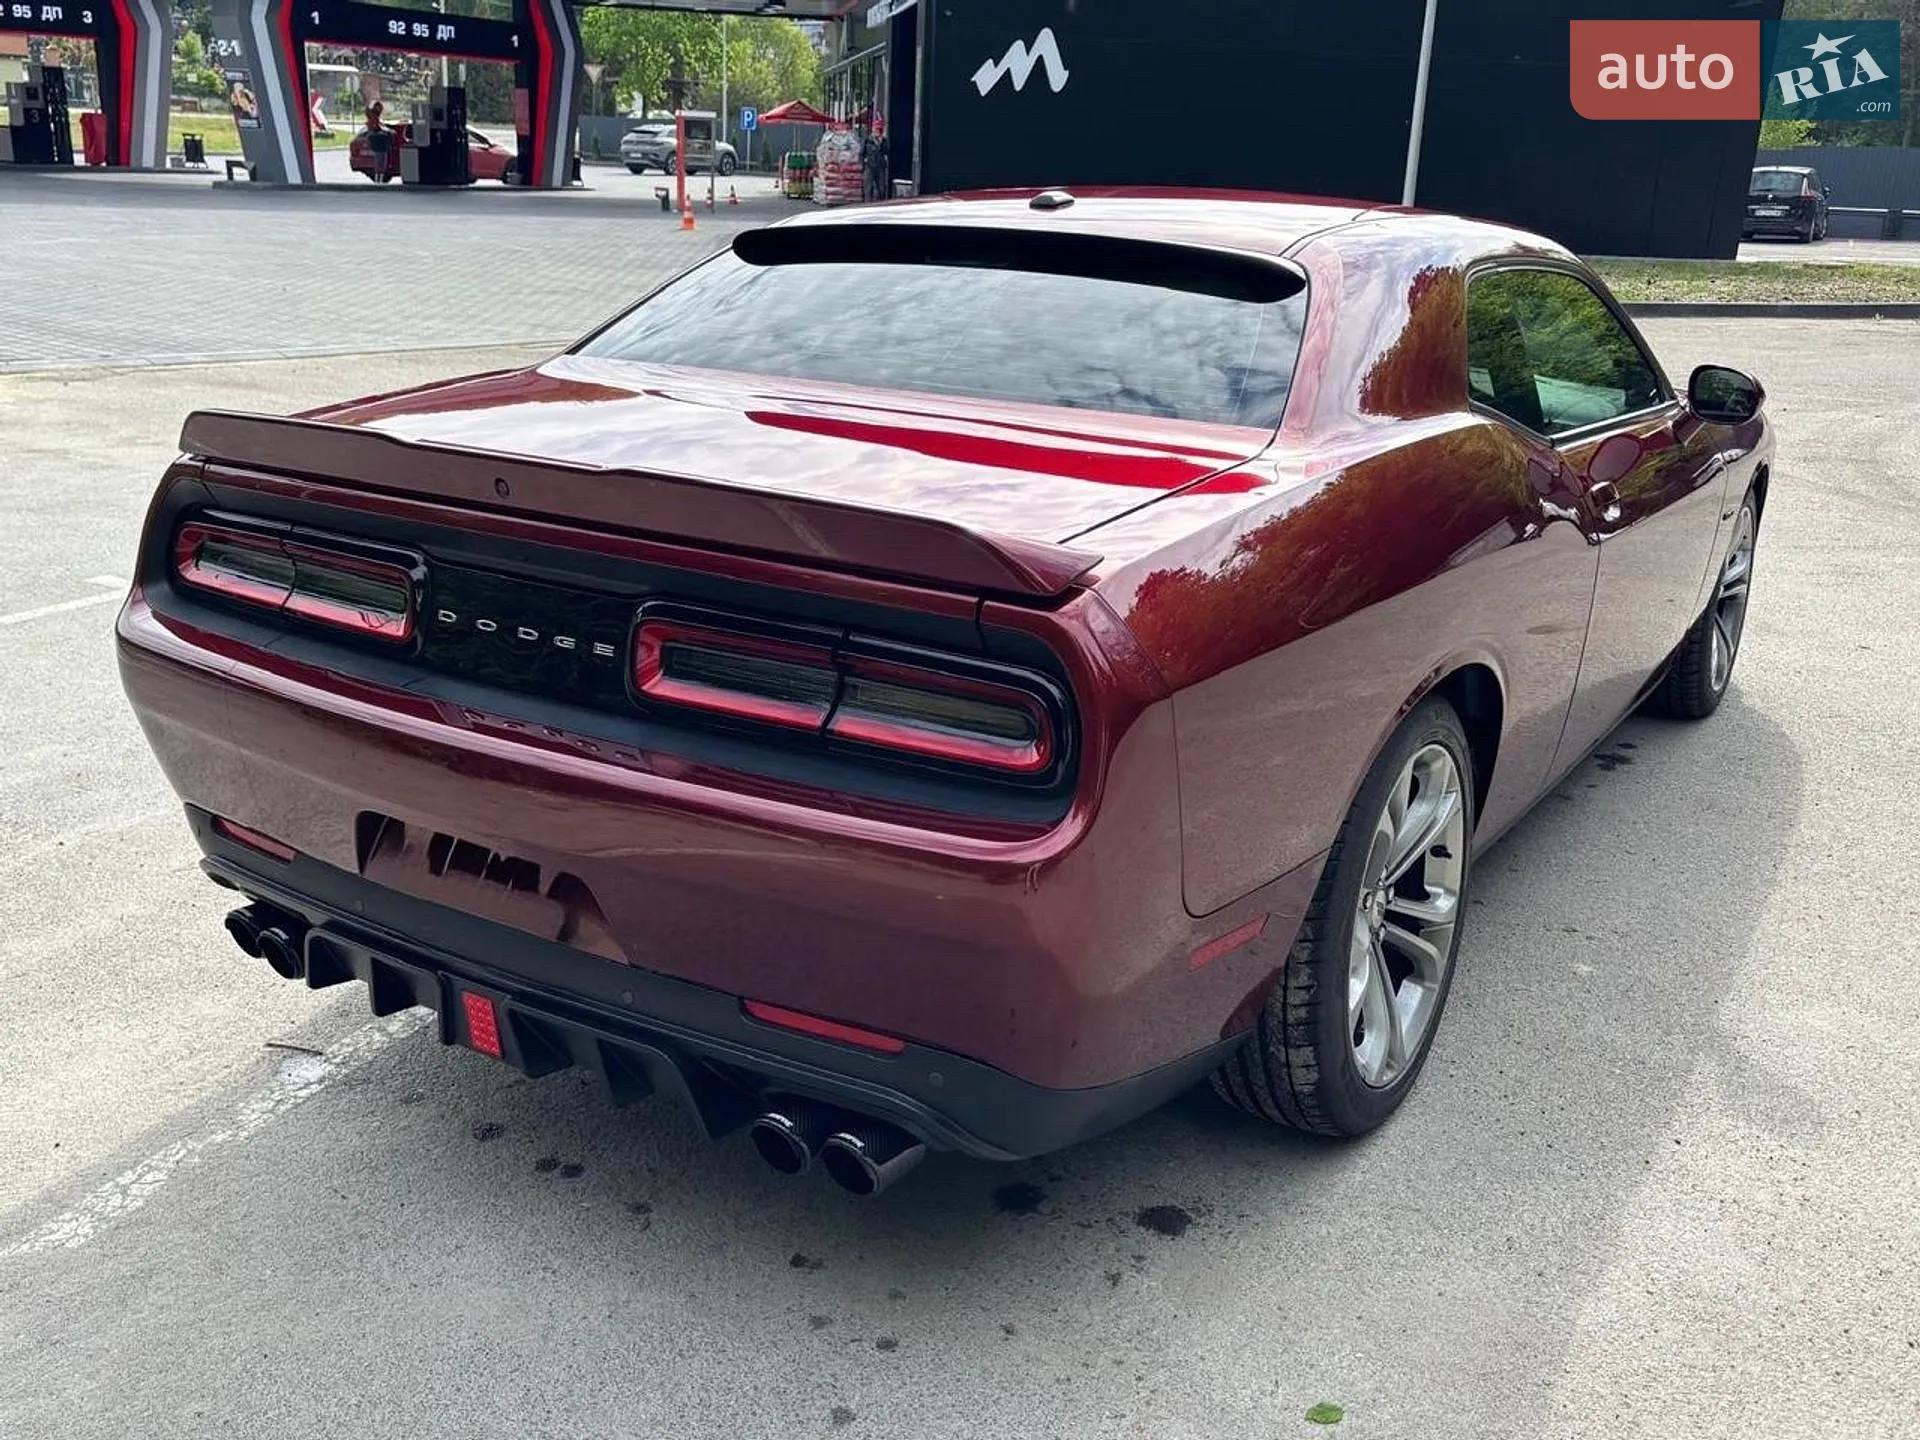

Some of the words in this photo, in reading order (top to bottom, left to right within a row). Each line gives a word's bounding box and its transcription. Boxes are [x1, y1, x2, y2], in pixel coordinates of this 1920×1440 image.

[12, 4, 32, 19] 95
[41, 5, 63, 21] ДП
[82, 10, 93, 24] 3
[310, 11, 320, 25] 1
[388, 20, 406, 35] 92
[412, 22, 429, 37] 95
[436, 24, 455, 41] ДП
[511, 34, 519, 48] 1
[744, 110, 753, 127] P
[437, 609, 616, 657] DODGE
